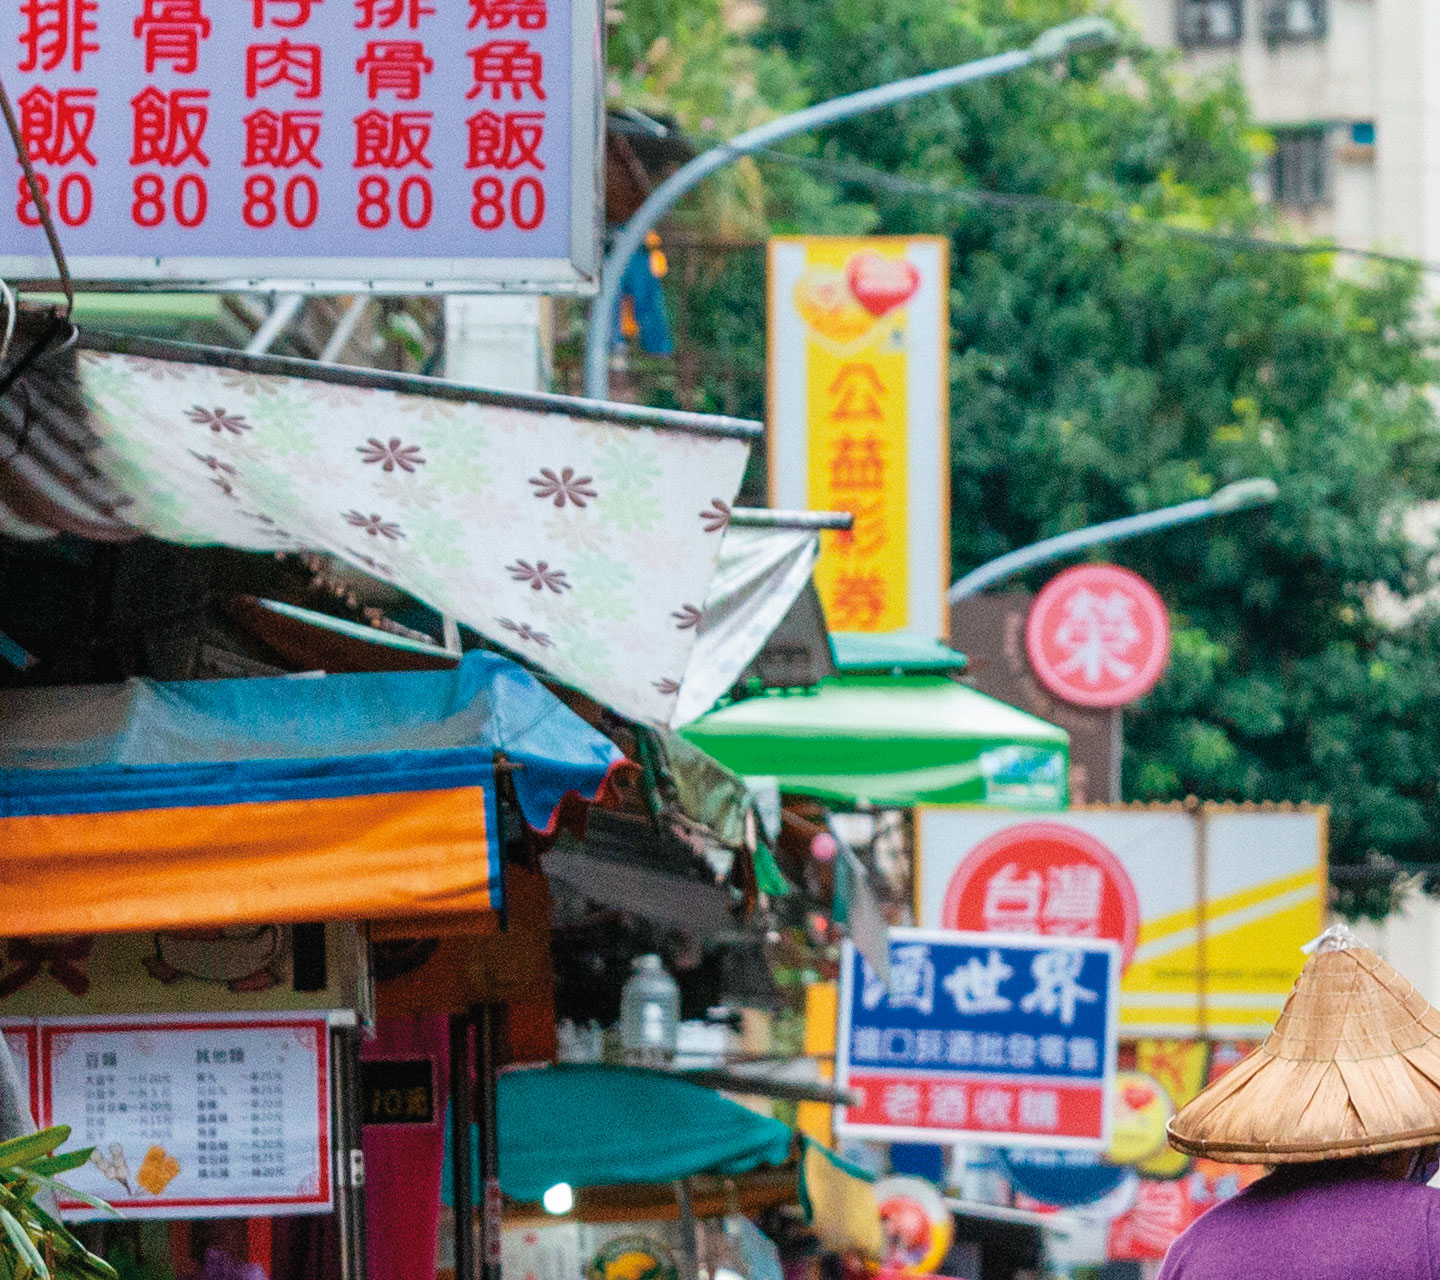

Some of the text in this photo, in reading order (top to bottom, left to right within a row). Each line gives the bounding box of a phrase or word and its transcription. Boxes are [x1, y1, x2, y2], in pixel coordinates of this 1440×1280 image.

[16, 171, 94, 228] 80
[131, 174, 210, 228] 80
[243, 174, 320, 230] 80
[356, 175, 435, 230] 80
[469, 175, 547, 231] 80
